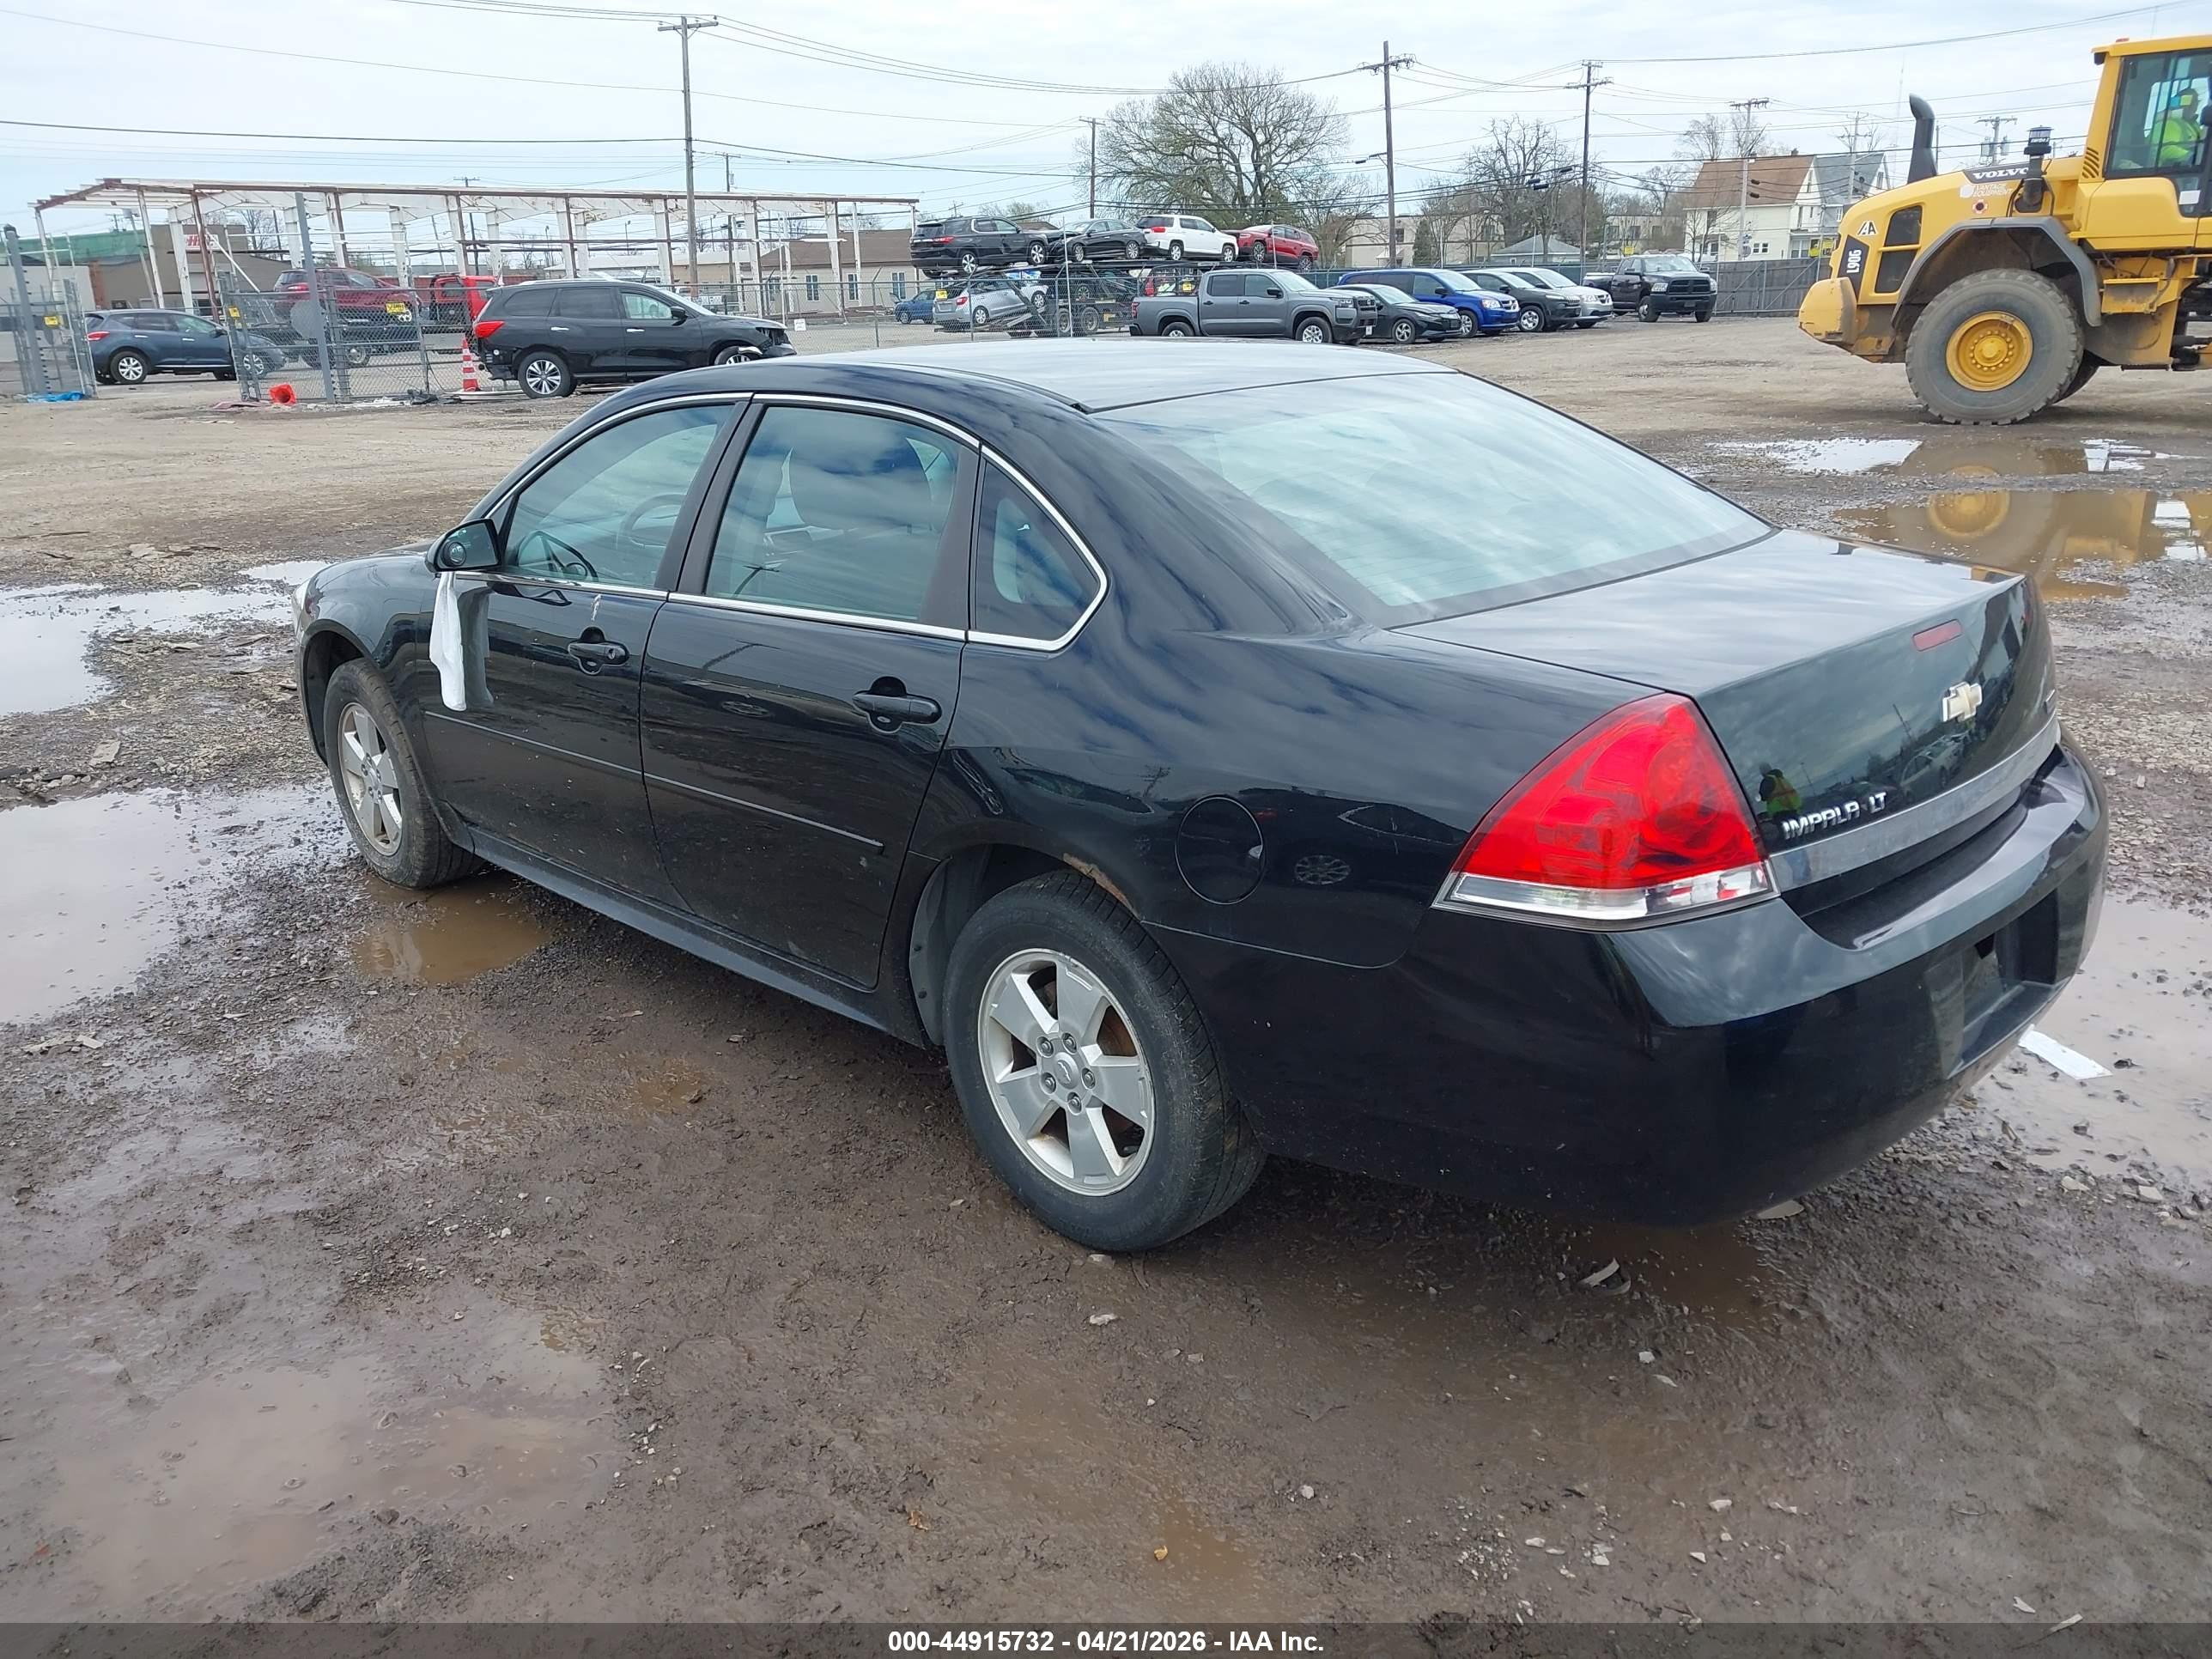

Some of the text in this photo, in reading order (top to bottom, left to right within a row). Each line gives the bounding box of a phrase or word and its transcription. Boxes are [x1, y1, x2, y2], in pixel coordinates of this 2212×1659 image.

[1846, 249, 1862, 274] L90G
[1782, 791, 1887, 840] IMPALA LT
